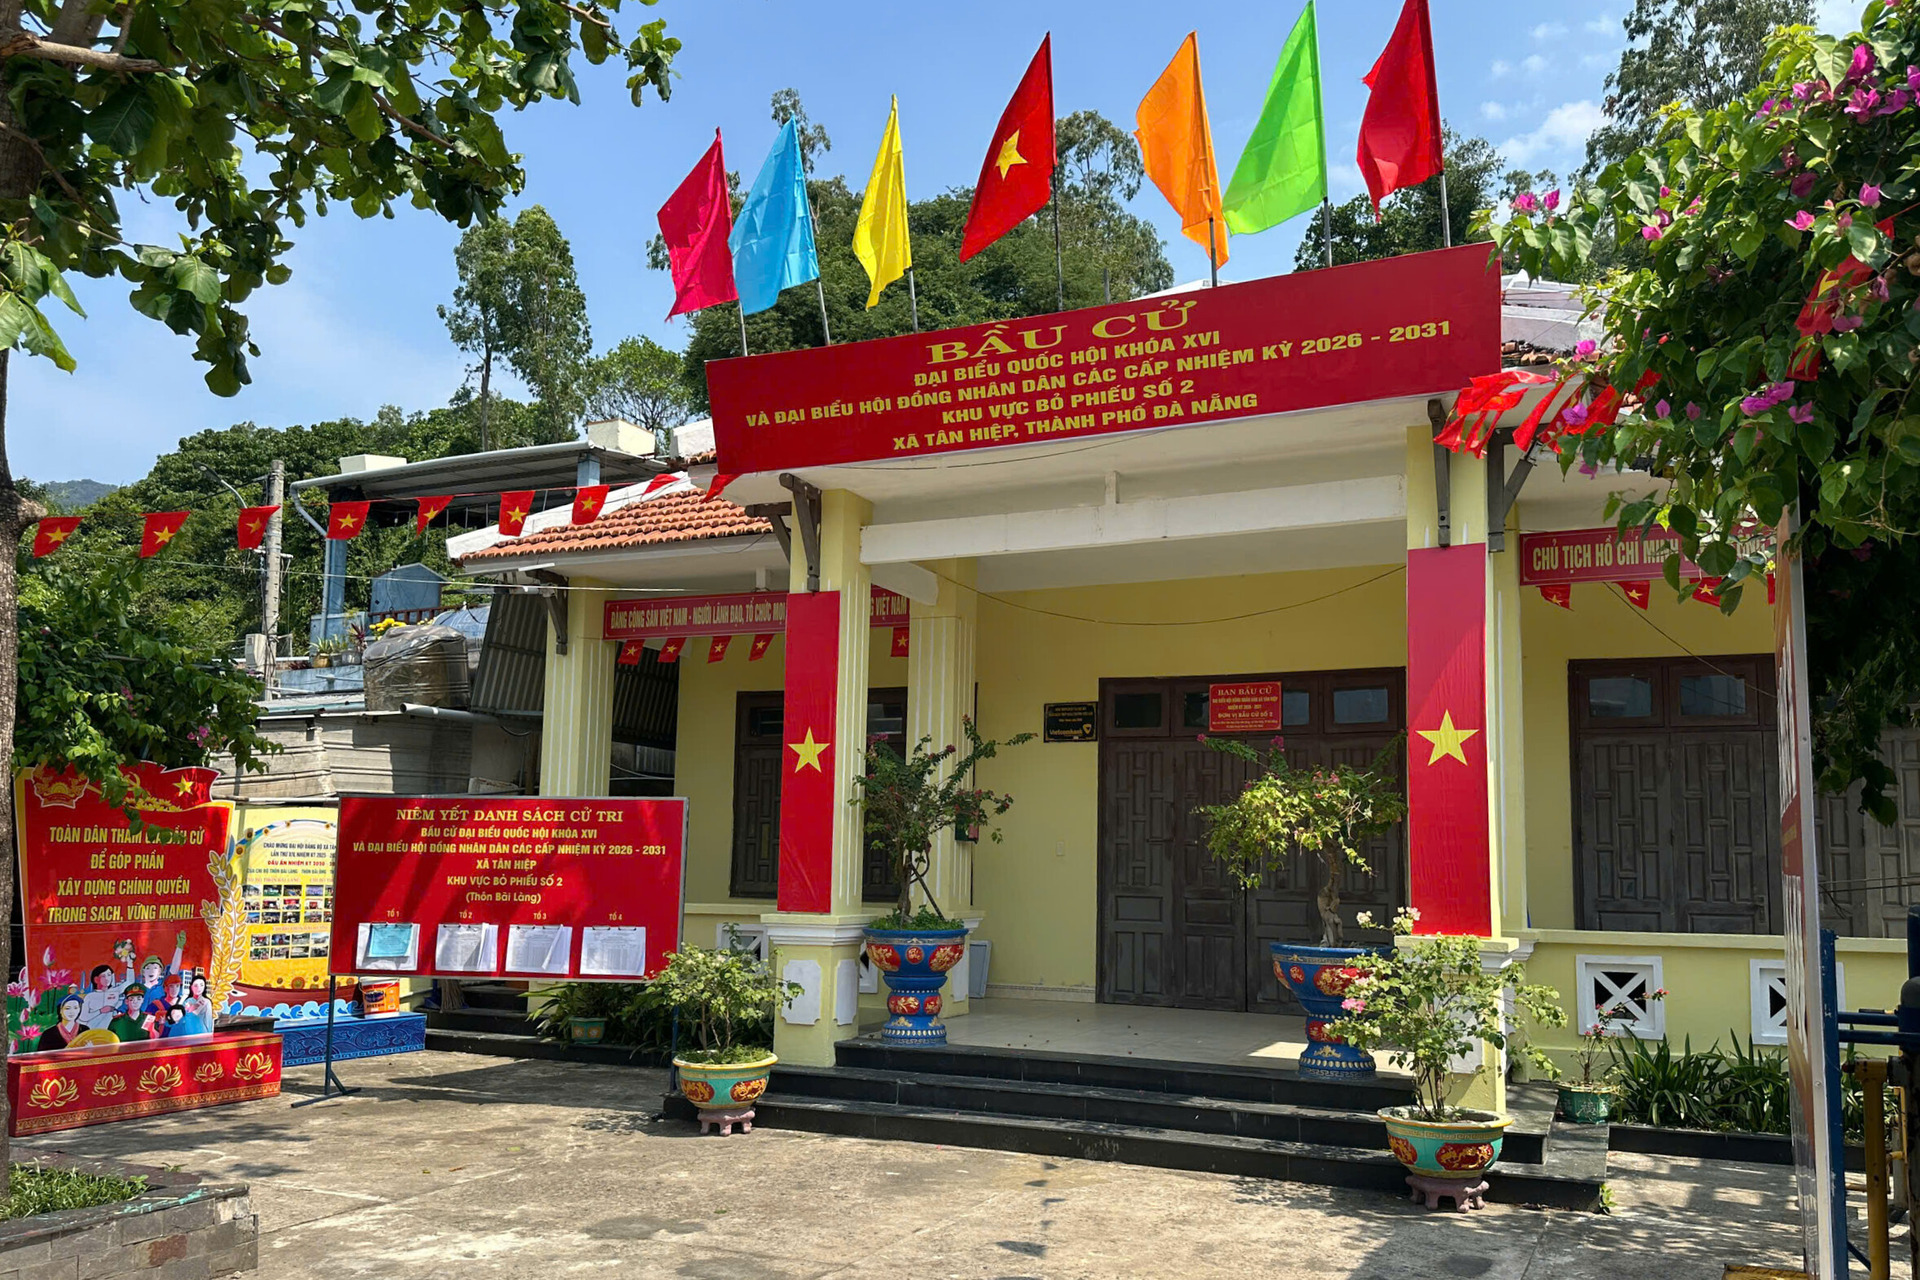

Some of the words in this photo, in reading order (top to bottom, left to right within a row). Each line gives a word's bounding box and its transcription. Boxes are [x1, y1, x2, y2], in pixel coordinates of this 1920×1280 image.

[926, 324, 1068, 364] BẦU
[1092, 299, 1197, 338] CỬ
[914, 370, 948, 387] ĐẠI
[954, 360, 1000, 382] BIỂU
[1007, 350, 1063, 375] QUỐC
[1071, 346, 1107, 365] HỘI
[1114, 337, 1175, 359] KHÓA
[1182, 330, 1220, 349] XVI
[746, 411, 770, 427] VÀ
[774, 408, 805, 425] ĐẠI
[811, 399, 853, 420] BIỂU
[859, 397, 892, 415] HỘI
[897, 390, 951, 409] ĐỒNG
[958, 381, 1015, 401] NHÂN
[1022, 374, 1066, 393] DÂN
[1073, 367, 1116, 386] CÁC
[1124, 358, 1169, 379] CẤP
[1177, 349, 1254, 373] NHIỆM
[1262, 340, 1293, 361] KỲ
[1301, 333, 1363, 355] 2026
[1389, 320, 1450, 342] 2031
[942, 407, 982, 424] KHU
[988, 400, 1029, 418] VỰC
[1036, 393, 1064, 412] BỎ
[1071, 384, 1135, 408] PHIẾU
[1143, 377, 1173, 398] SỐ
[1180, 380, 1194, 394] 2
[893, 434, 919, 450] XÃ
[925, 430, 963, 446] TÂN
[970, 423, 1019, 442] HIỆP,
[1025, 415, 1095, 434] THÀNH
[1103, 403, 1146, 426] PHỐ
[1153, 401, 1184, 419] ĐÀ
[1192, 393, 1258, 415] NẴNG
[1533, 538, 1559, 571] CHỦ
[1562, 544, 1592, 574] TỊCH
[1595, 535, 1613, 567] HỒ
[1617, 535, 1639, 566] CHÍ
[891, 595, 907, 615] NAM
[611, 606, 627, 629] ĐẢNG
[629, 607, 645, 632] CỘNG
[646, 604, 658, 627] SẢN
[660, 605, 672, 630] VIỆT
[673, 608, 688, 626] NAM
[693, 602, 711, 624] NGƯỜI
[713, 603, 729, 623] LÃNH
[396, 807, 435, 821] NIÊM
[440, 805, 469, 821] YẾT
[473, 810, 518, 821] DANH
[522, 807, 565, 822] SÁCH
[570, 806, 592, 822] CỬ
[596, 811, 624, 822] TRI
[50, 824, 80, 843] TOÀN
[83, 825, 107, 843] DÂN
[190, 826, 205, 845] CỬ
[443, 826, 457, 838] CỬ
[459, 828, 475, 840] ĐẠI
[478, 825, 500, 838] BIỂU
[503, 826, 530, 839] QUỐC
[532, 827, 549, 839] HỘI
[552, 827, 578, 838] KHÓA
[581, 829, 597, 839] XVI
[91, 848, 107, 869] ĐỂ
[109, 851, 131, 869] GÓP
[134, 850, 164, 869] PHẦN
[353, 841, 365, 852] VÀ
[368, 842, 384, 854] ĐẠI
[386, 839, 408, 852] BIỂU
[411, 841, 427, 855] HỘI
[459, 842, 486, 854] NHÂN
[489, 842, 509, 854] DÂN
[512, 842, 532, 854] CÁC
[535, 840, 555, 855] CẤP
[557, 843, 590, 857] NHIỆM
[593, 842, 606, 855] KỲ
[608, 845, 633, 855] 2026
[642, 845, 666, 855] 2031
[476, 858, 489, 869] XÃ
[492, 858, 511, 869] TÂN
[514, 859, 537, 872] HIỆP
[57, 877, 81, 896] XÂY
[84, 878, 115, 899] DỰNG
[119, 877, 152, 895] CHÍNH
[156, 875, 190, 896] QUYỀN
[447, 876, 467, 885] KHU
[470, 875, 490, 888] VỰC
[493, 873, 507, 886] BỎ
[510, 874, 537, 886] PHIẾU
[540, 874, 554, 886] SỐ
[557, 877, 563, 886] 2
[466, 891, 492, 903] (Thôn
[496, 892, 511, 901] Bãi
[514, 892, 541, 904] Làng)
[48, 907, 87, 923] TRONG
[127, 902, 156, 920] VỮNG
[159, 903, 195, 922] MẠNH!
